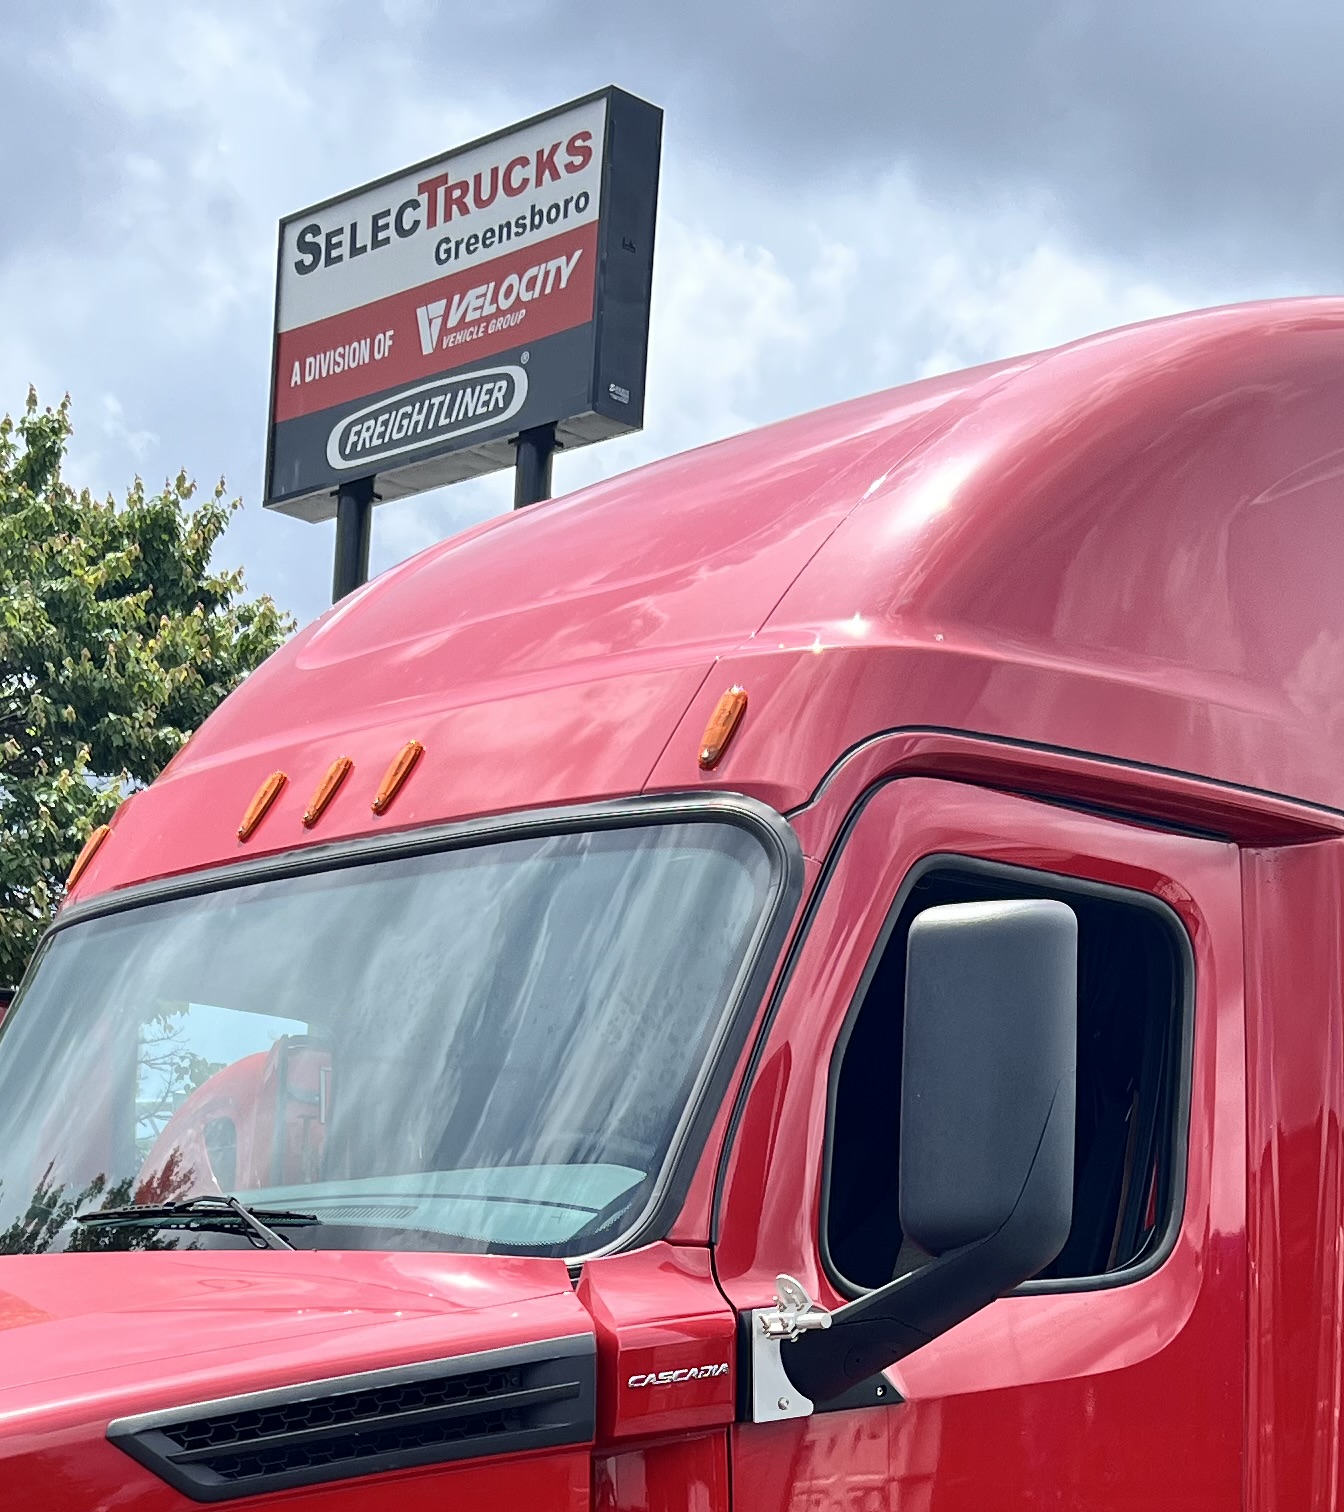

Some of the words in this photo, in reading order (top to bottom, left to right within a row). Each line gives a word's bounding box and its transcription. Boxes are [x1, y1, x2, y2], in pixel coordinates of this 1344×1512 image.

[435, 191, 590, 265] Greensboro
[447, 249, 583, 328] VELOCITY
[290, 361, 301, 387] A
[305, 338, 371, 383] DIVISION
[374, 330, 394, 360] OF
[442, 323, 486, 349] VEHICLE
[488, 309, 526, 334] GROUP
[345, 380, 508, 455] FREIGHTLINER
[628, 1362, 729, 1388] CASCADIA
